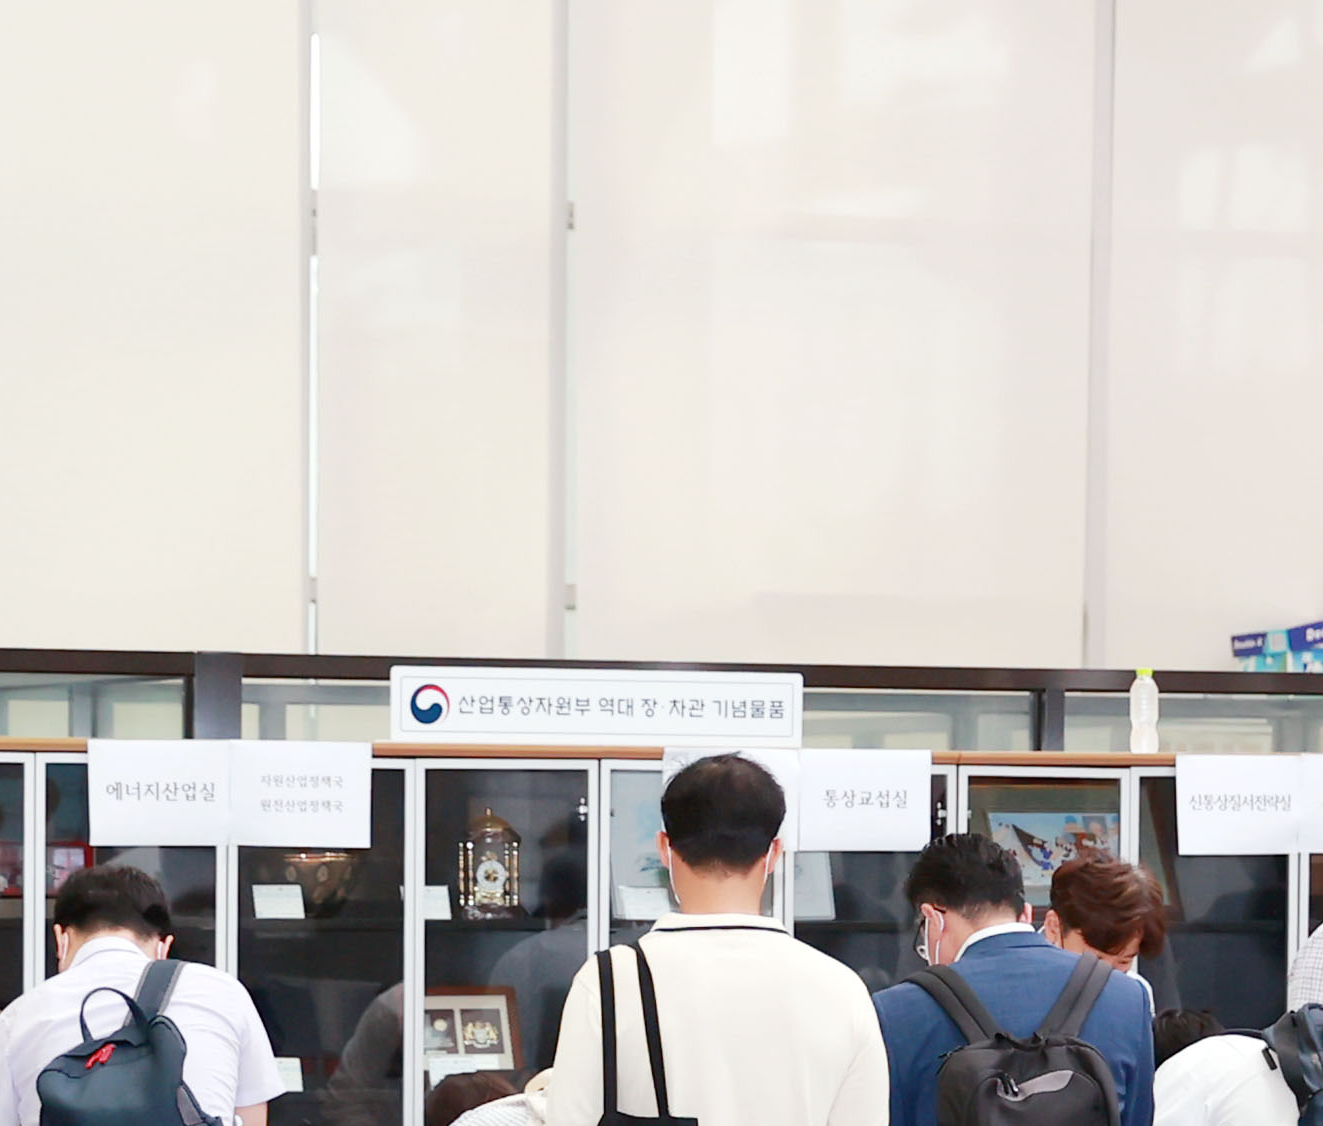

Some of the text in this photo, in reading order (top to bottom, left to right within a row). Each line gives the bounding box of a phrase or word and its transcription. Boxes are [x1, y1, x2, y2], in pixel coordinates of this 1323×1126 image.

[459, 695, 590, 716] 산업통상자원부
[598, 697, 634, 717] 역대
[712, 699, 784, 719] 기념물품
[260, 774, 343, 789] 자원산업정책국
[105, 781, 215, 803] 에너지산업실
[823, 789, 908, 809] 통상교섭실
[260, 798, 343, 814] 원전산업정책국
[1189, 793, 1292, 812] 신통상질서전략실
